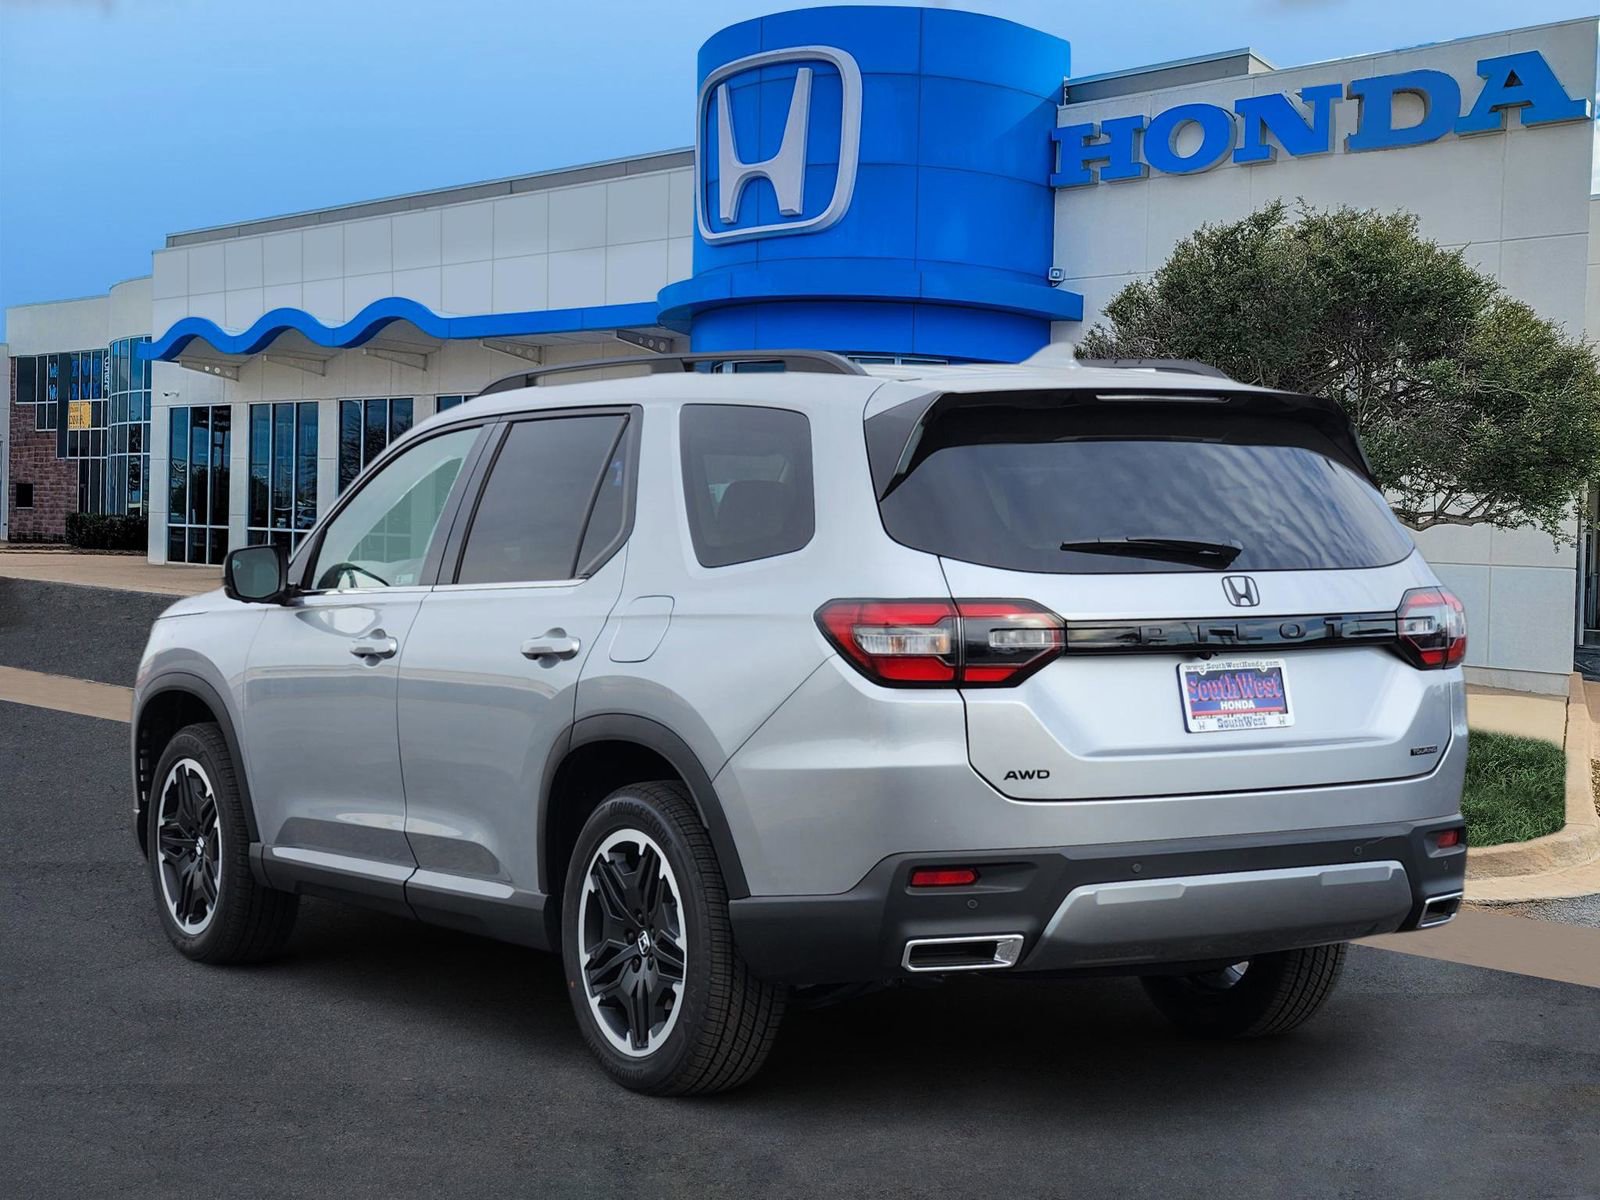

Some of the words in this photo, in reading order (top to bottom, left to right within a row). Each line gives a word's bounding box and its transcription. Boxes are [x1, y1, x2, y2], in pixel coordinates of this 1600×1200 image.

[1050, 50, 1591, 188] HONDA
[1138, 615, 1345, 643] PILOT
[1220, 699, 1256, 711] HONDA
[1003, 769, 1050, 781] AWD
